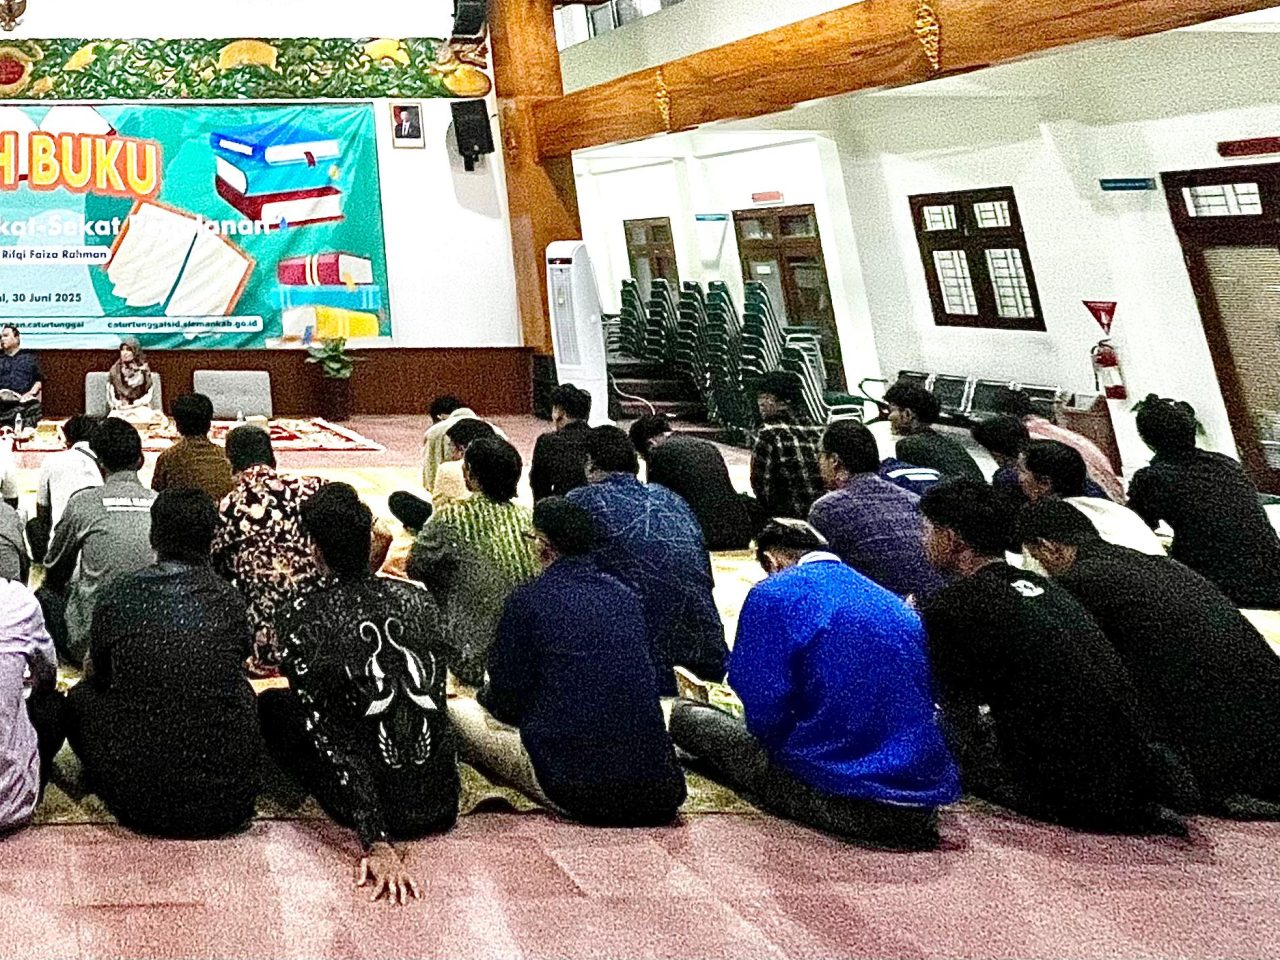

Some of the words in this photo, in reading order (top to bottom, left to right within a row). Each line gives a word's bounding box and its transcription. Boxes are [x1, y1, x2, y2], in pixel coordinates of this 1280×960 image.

[30, 132, 161, 198] BUKU
[2, 249, 26, 261] Rifqi
[29, 250, 59, 260] Faiza
[62, 249, 107, 259] Rahman
[12, 293, 26, 303] 30
[29, 293, 52, 303] Juni
[55, 293, 82, 303] 2025
